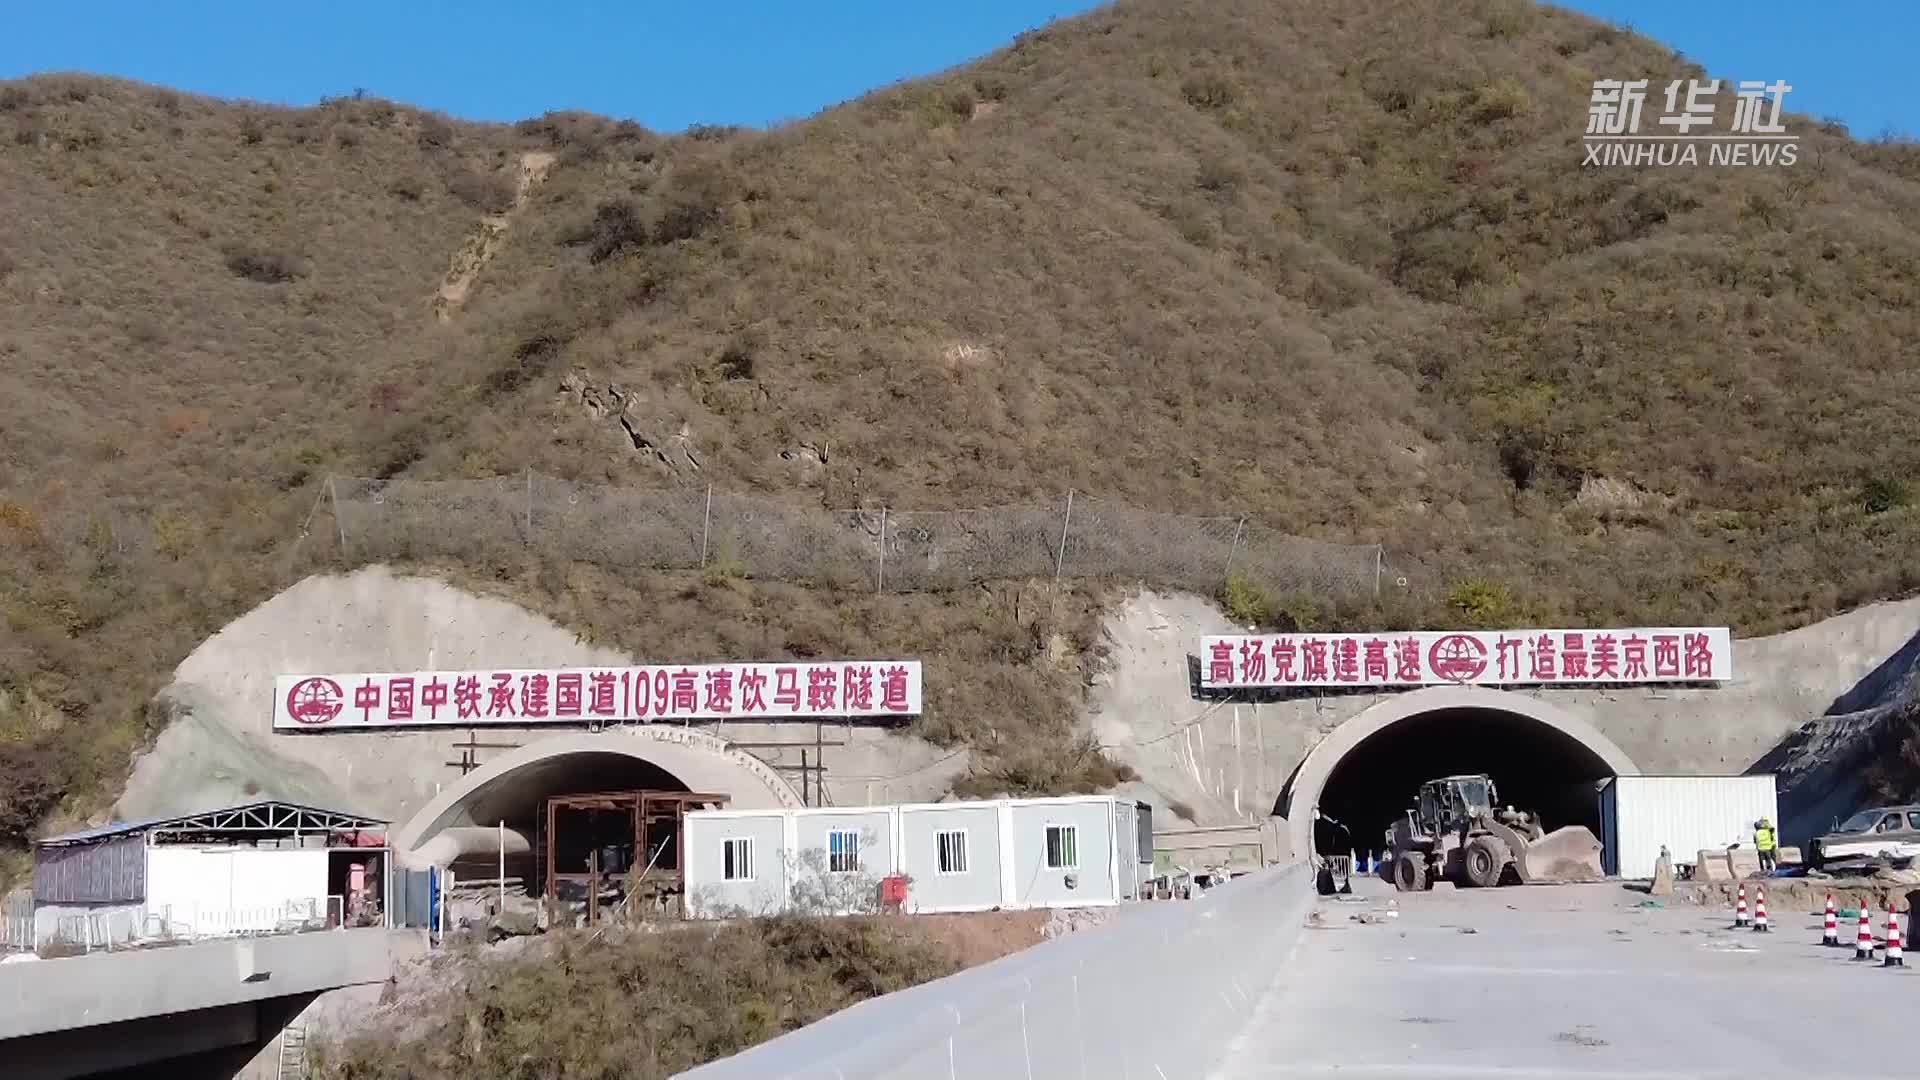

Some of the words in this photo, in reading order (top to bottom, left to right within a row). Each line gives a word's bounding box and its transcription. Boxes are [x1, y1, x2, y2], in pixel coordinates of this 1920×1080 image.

[1209, 637, 1421, 682] 高扬党旗建高速
[1497, 633, 1713, 680] 打造最美京西路
[354, 665, 908, 720] 中国中铁承建国道109高速饮马鞍隧道
